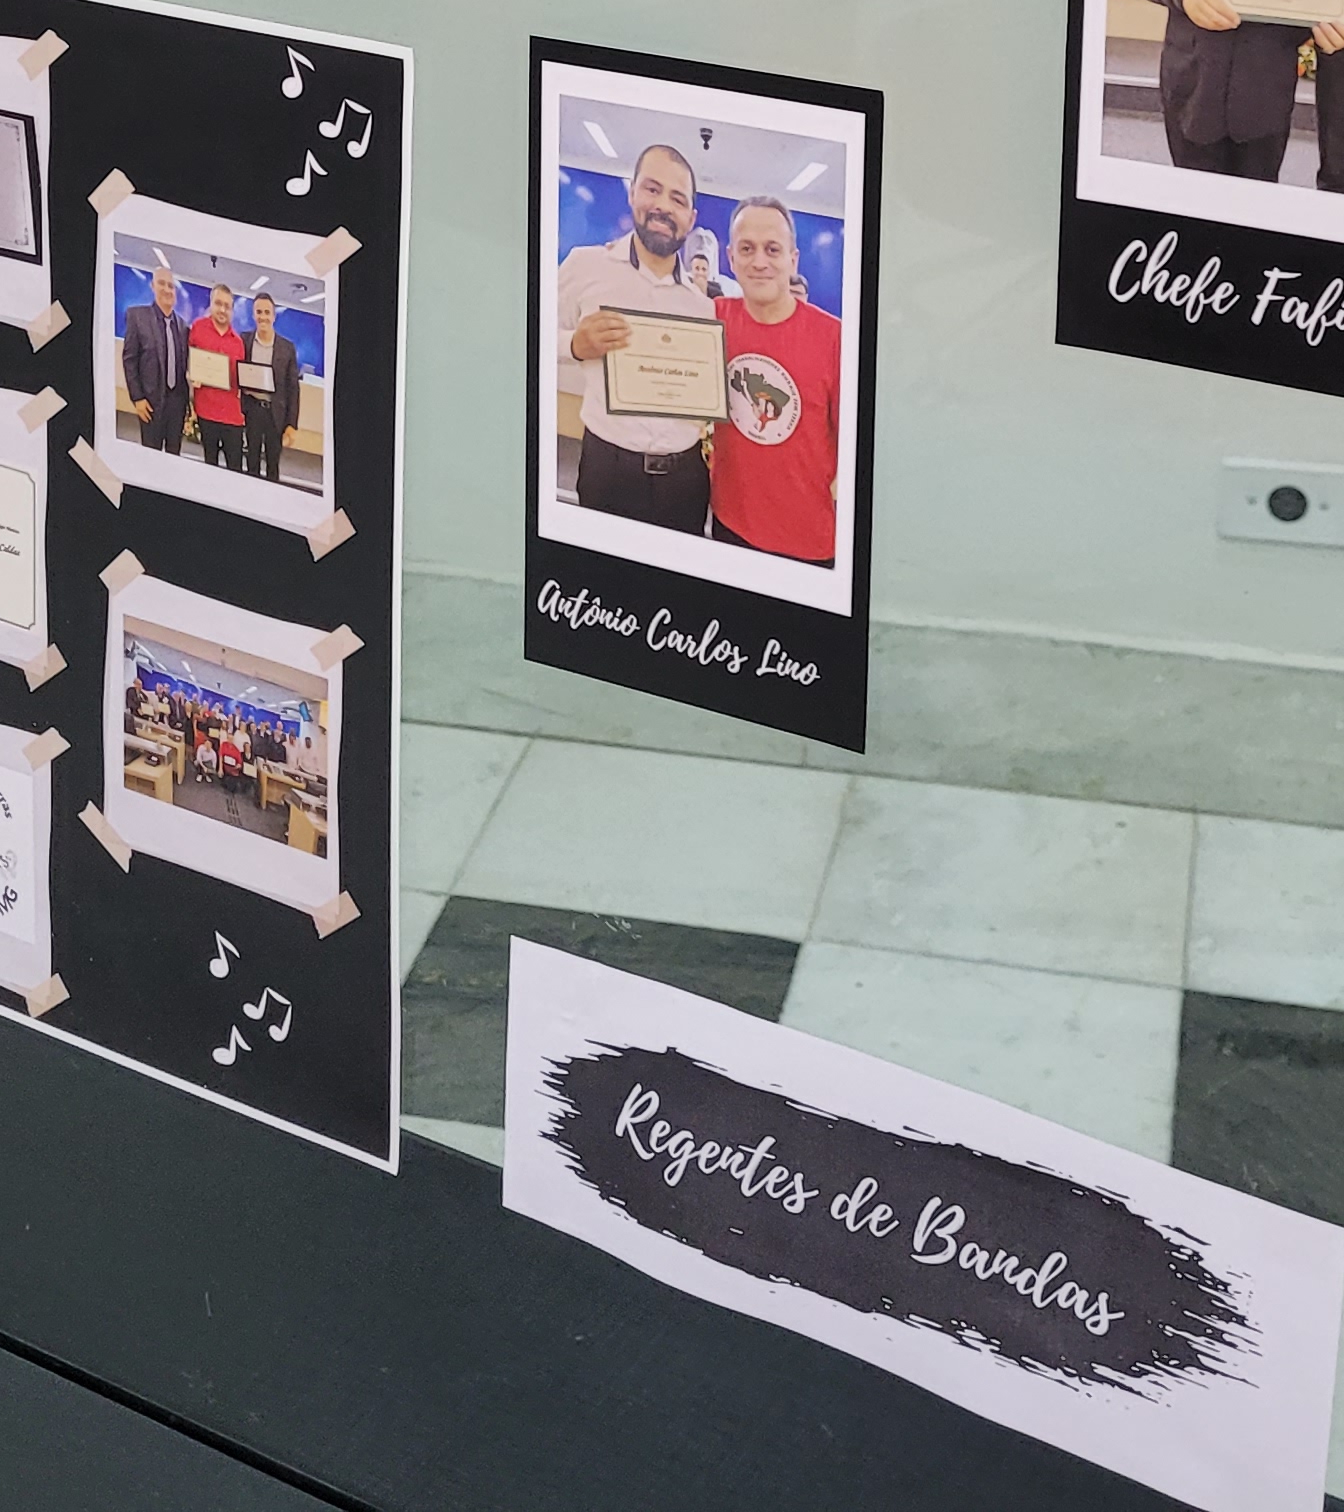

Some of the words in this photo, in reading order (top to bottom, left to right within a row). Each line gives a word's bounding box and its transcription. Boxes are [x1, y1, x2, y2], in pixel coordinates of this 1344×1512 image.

[1108, 231, 1240, 323] Chefe
[537, 579, 641, 637] Antônio
[646, 607, 749, 674] Carlos
[755, 638, 821, 686] Lino
[614, 1083, 819, 1214] Regentes
[829, 1176, 900, 1240] de
[911, 1195, 1125, 1336] Bandas
